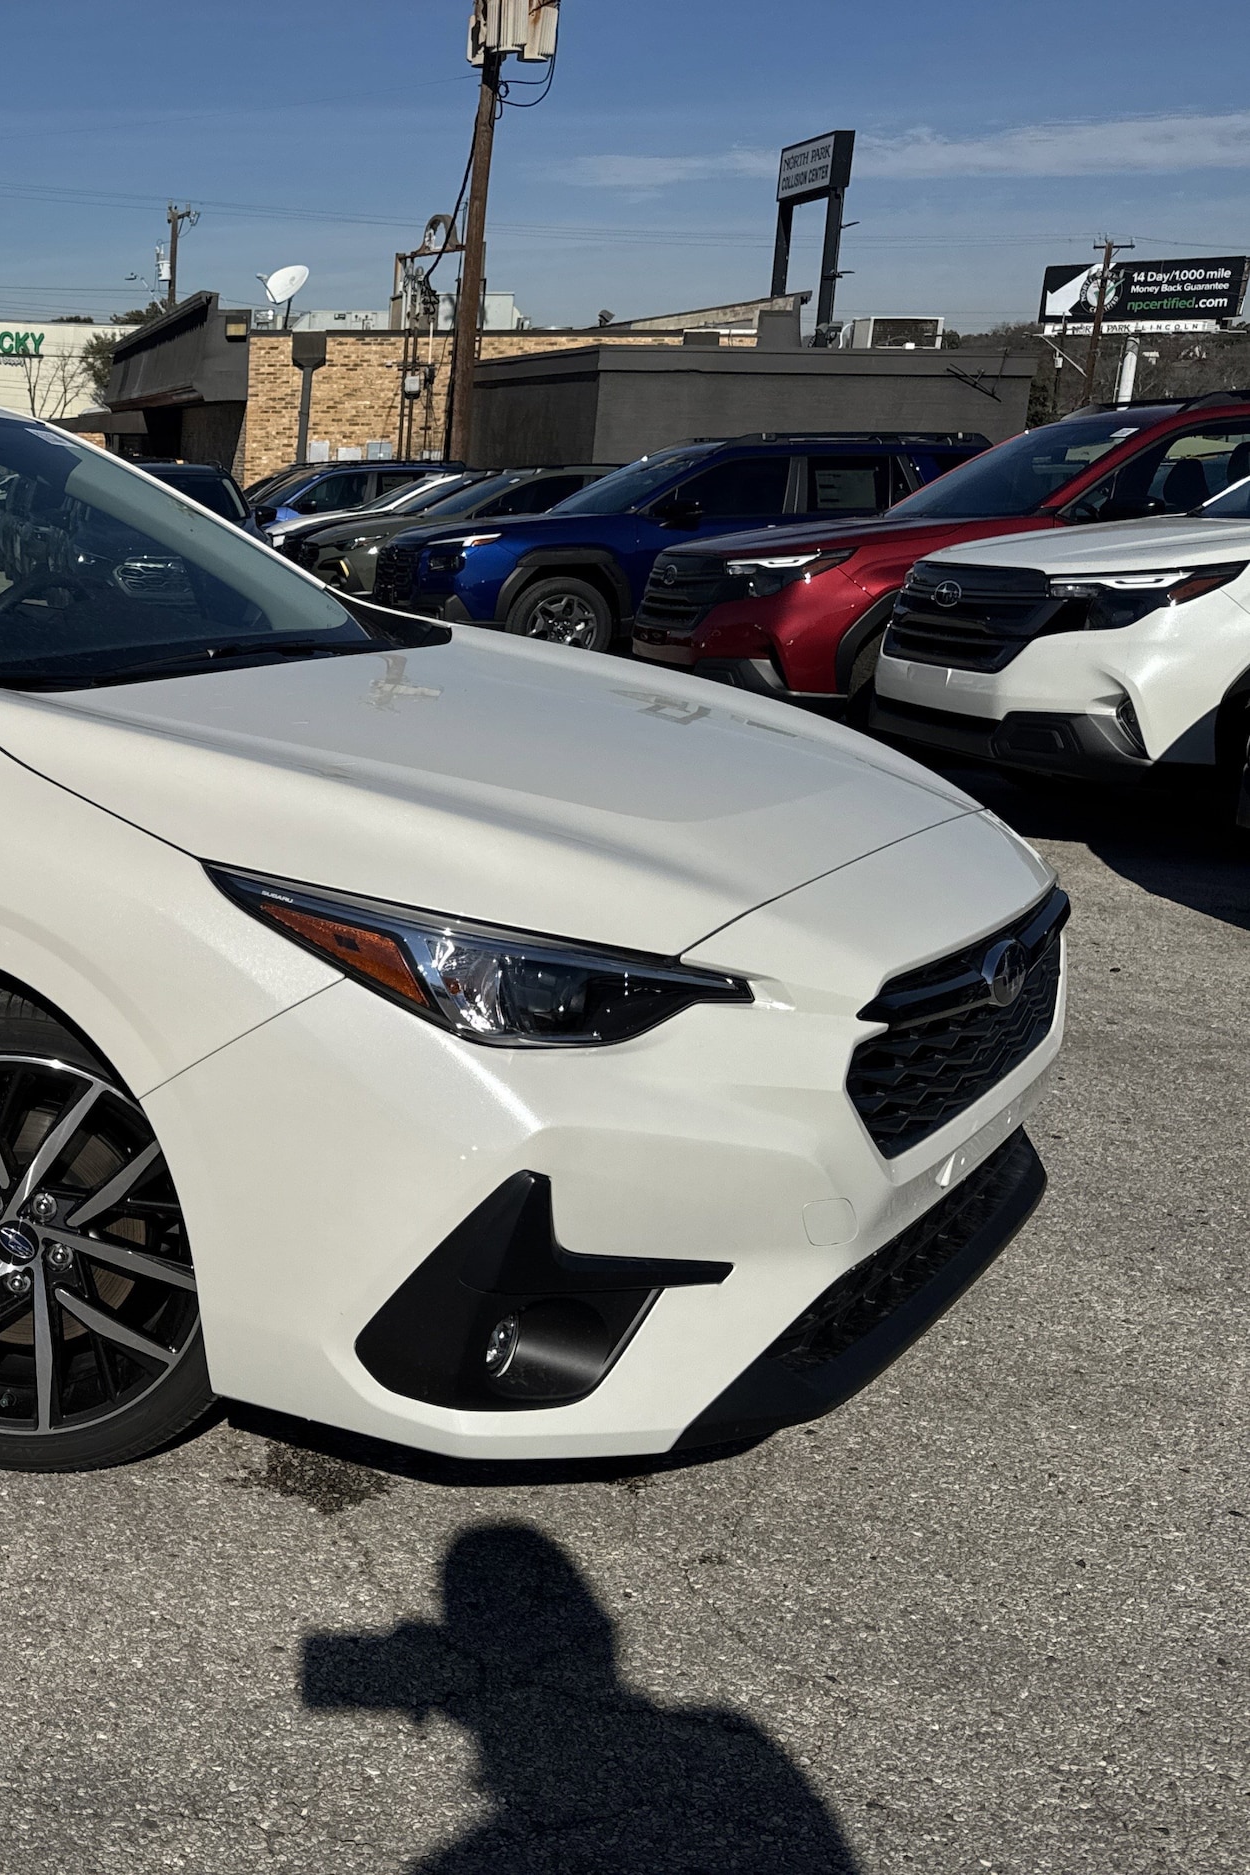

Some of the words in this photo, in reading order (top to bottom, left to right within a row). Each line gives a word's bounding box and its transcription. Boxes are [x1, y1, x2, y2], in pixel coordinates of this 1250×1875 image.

[810, 144, 831, 163] PARK
[808, 164, 829, 183] CENTER
[1132, 271, 1145, 283] 14
[1206, 267, 1232, 280] mile
[1130, 285, 1160, 294] Money
[1161, 283, 1182, 292] Back
[1184, 281, 1230, 291] Guarantee
[1127, 297, 1228, 313] npcertified.com
[1106, 324, 1131, 333] PARK
[1141, 323, 1199, 331] LINCOLN
[261, 890, 294, 903] SUBARU
